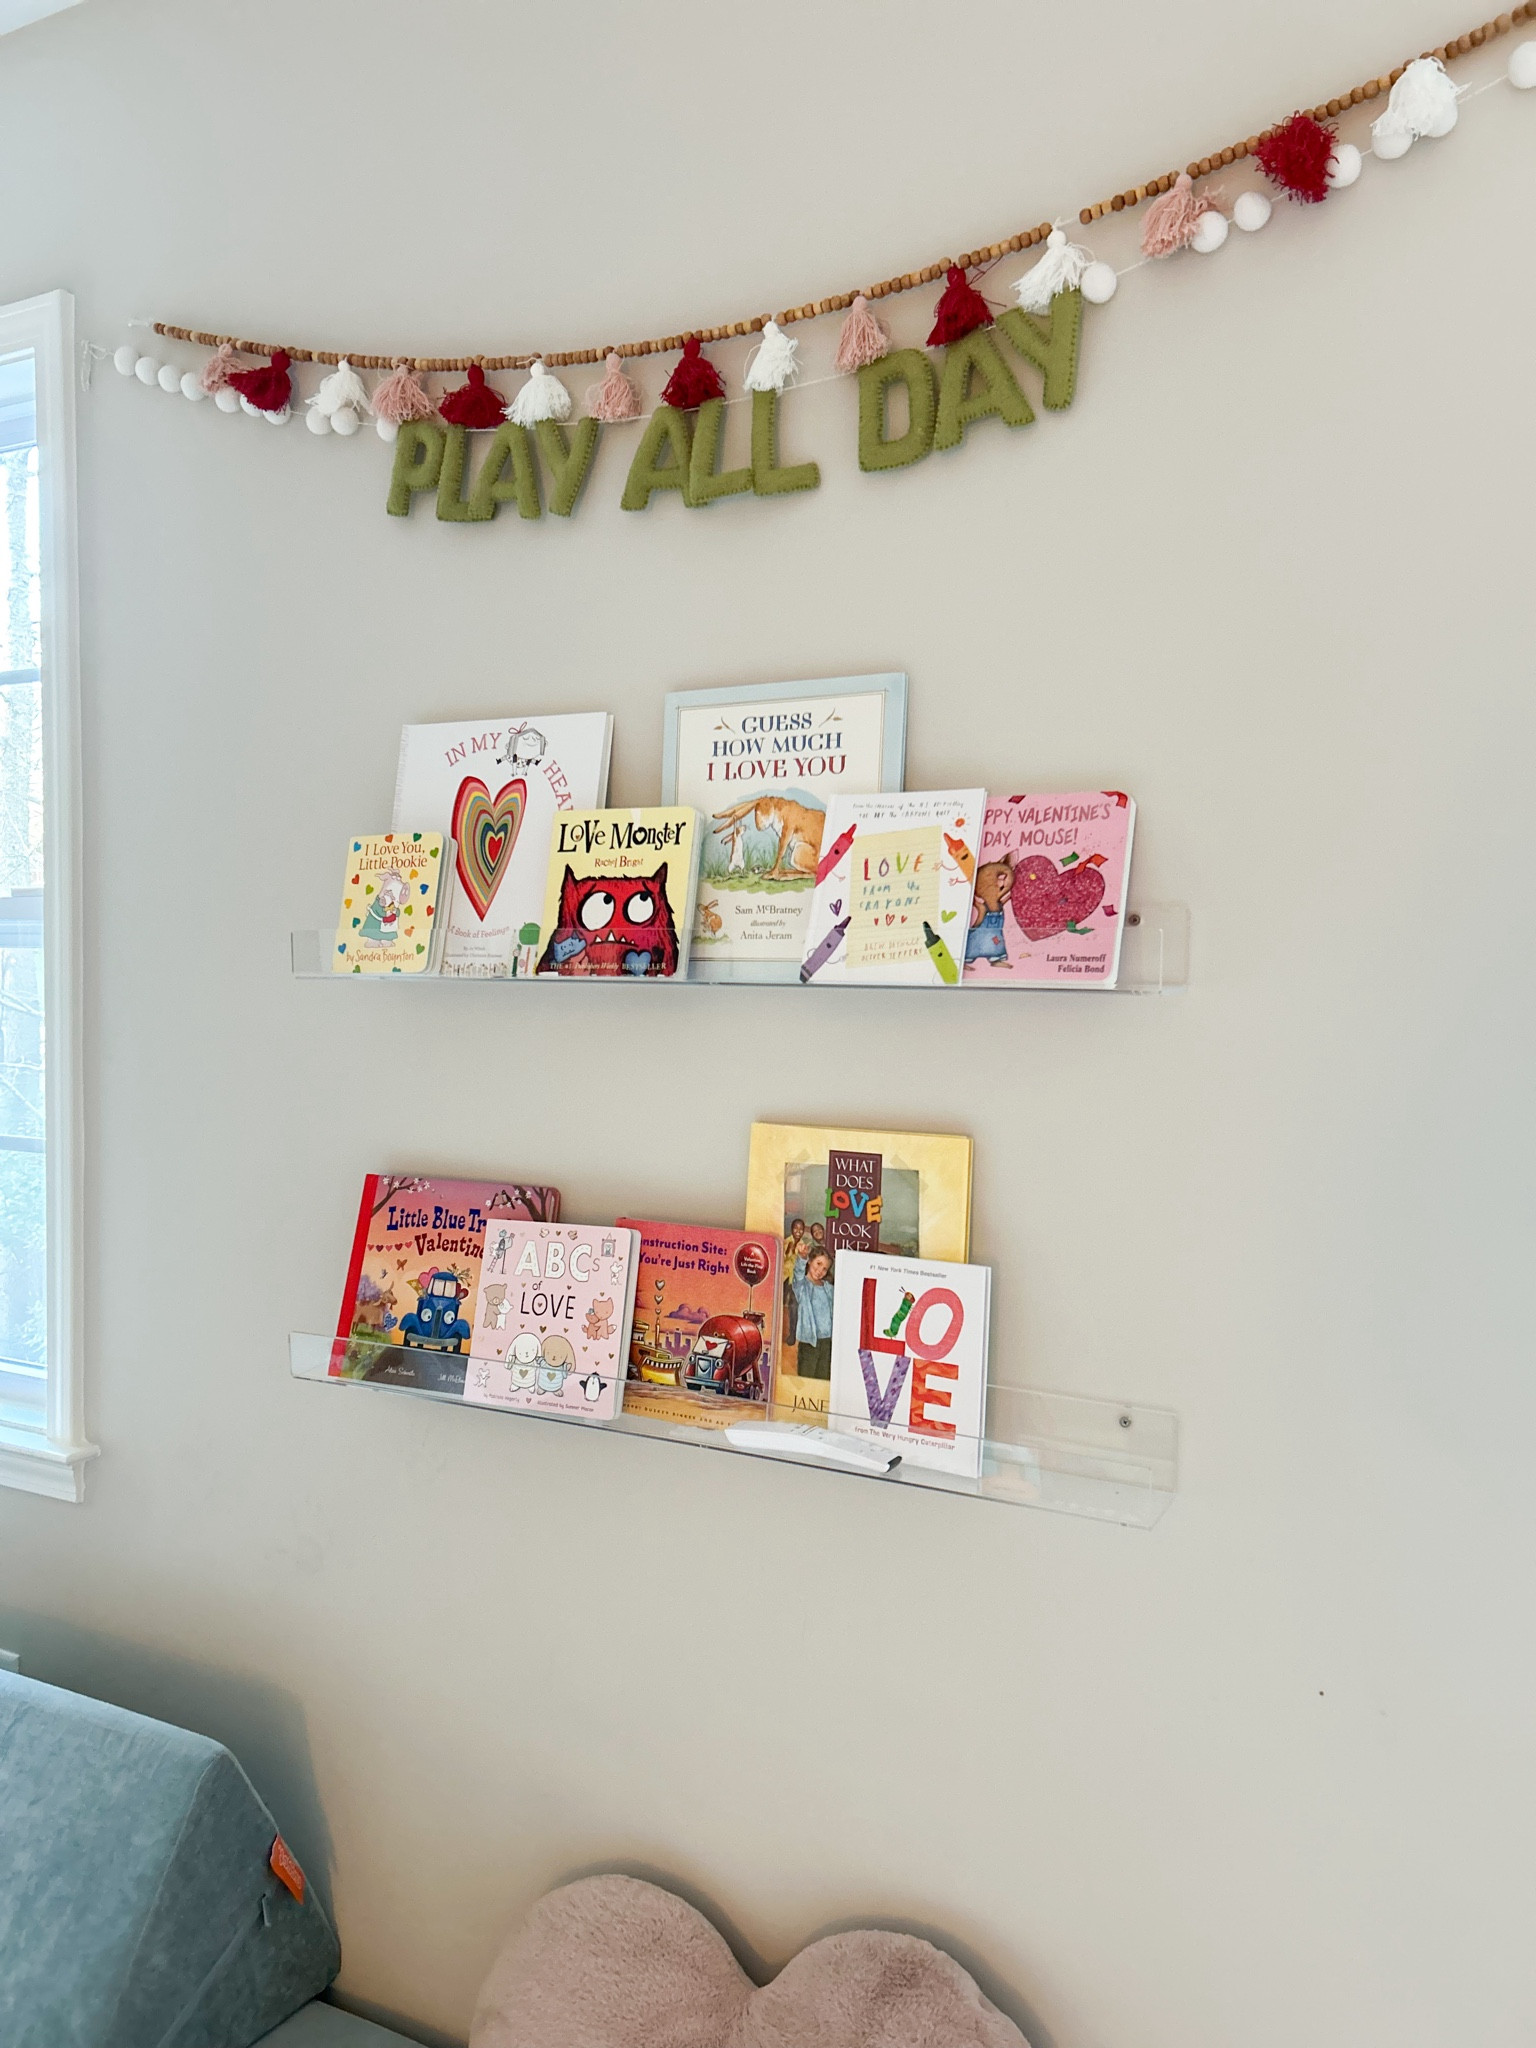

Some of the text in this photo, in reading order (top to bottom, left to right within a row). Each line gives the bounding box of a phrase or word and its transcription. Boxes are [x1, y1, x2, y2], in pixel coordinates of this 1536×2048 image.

[386, 286, 1083, 522] PLAY ALL DAY
[741, 712, 812, 734] GUESS
[444, 732, 502, 767] IN MY
[711, 732, 843, 757] HOW MUCH
[706, 754, 847, 781] I LOVE YOU
[983, 803, 1111, 825] PPY VALENTINE'S
[609, 822, 687, 850] Monster
[1019, 827, 1078, 847] MOUSE!
[365, 844, 370, 856] I
[373, 843, 400, 856] Love
[359, 856, 428, 870] Little Pookie
[864, 852, 923, 881] LOVE
[735, 904, 803, 916] Sam McBratney
[860, 896, 920, 911] CRAYONS
[454, 928, 471, 938] Book
[740, 930, 793, 940] Anita Jeram
[1046, 954, 1067, 962] Laura
[1057, 965, 1105, 973] Felicia Bond
[835, 1158, 876, 1173] WHAT
[836, 1174, 874, 1190] DOES
[824, 1188, 883, 1224] LOVE
[386, 1206, 488, 1232] Little Blue Tr
[832, 1222, 872, 1238] LOOK
[702, 1242, 728, 1256] Site:
[672, 1256, 696, 1270] Just
[698, 1258, 730, 1276] Right
[904, 1268, 919, 1276] Times
[532, 1280, 542, 1290] of
[520, 1292, 576, 1320] LOVE
[855, 1426, 868, 1434] from
[870, 1428, 880, 1436] The
[882, 1432, 896, 1441] Very
[898, 1434, 919, 1446] Hungry
